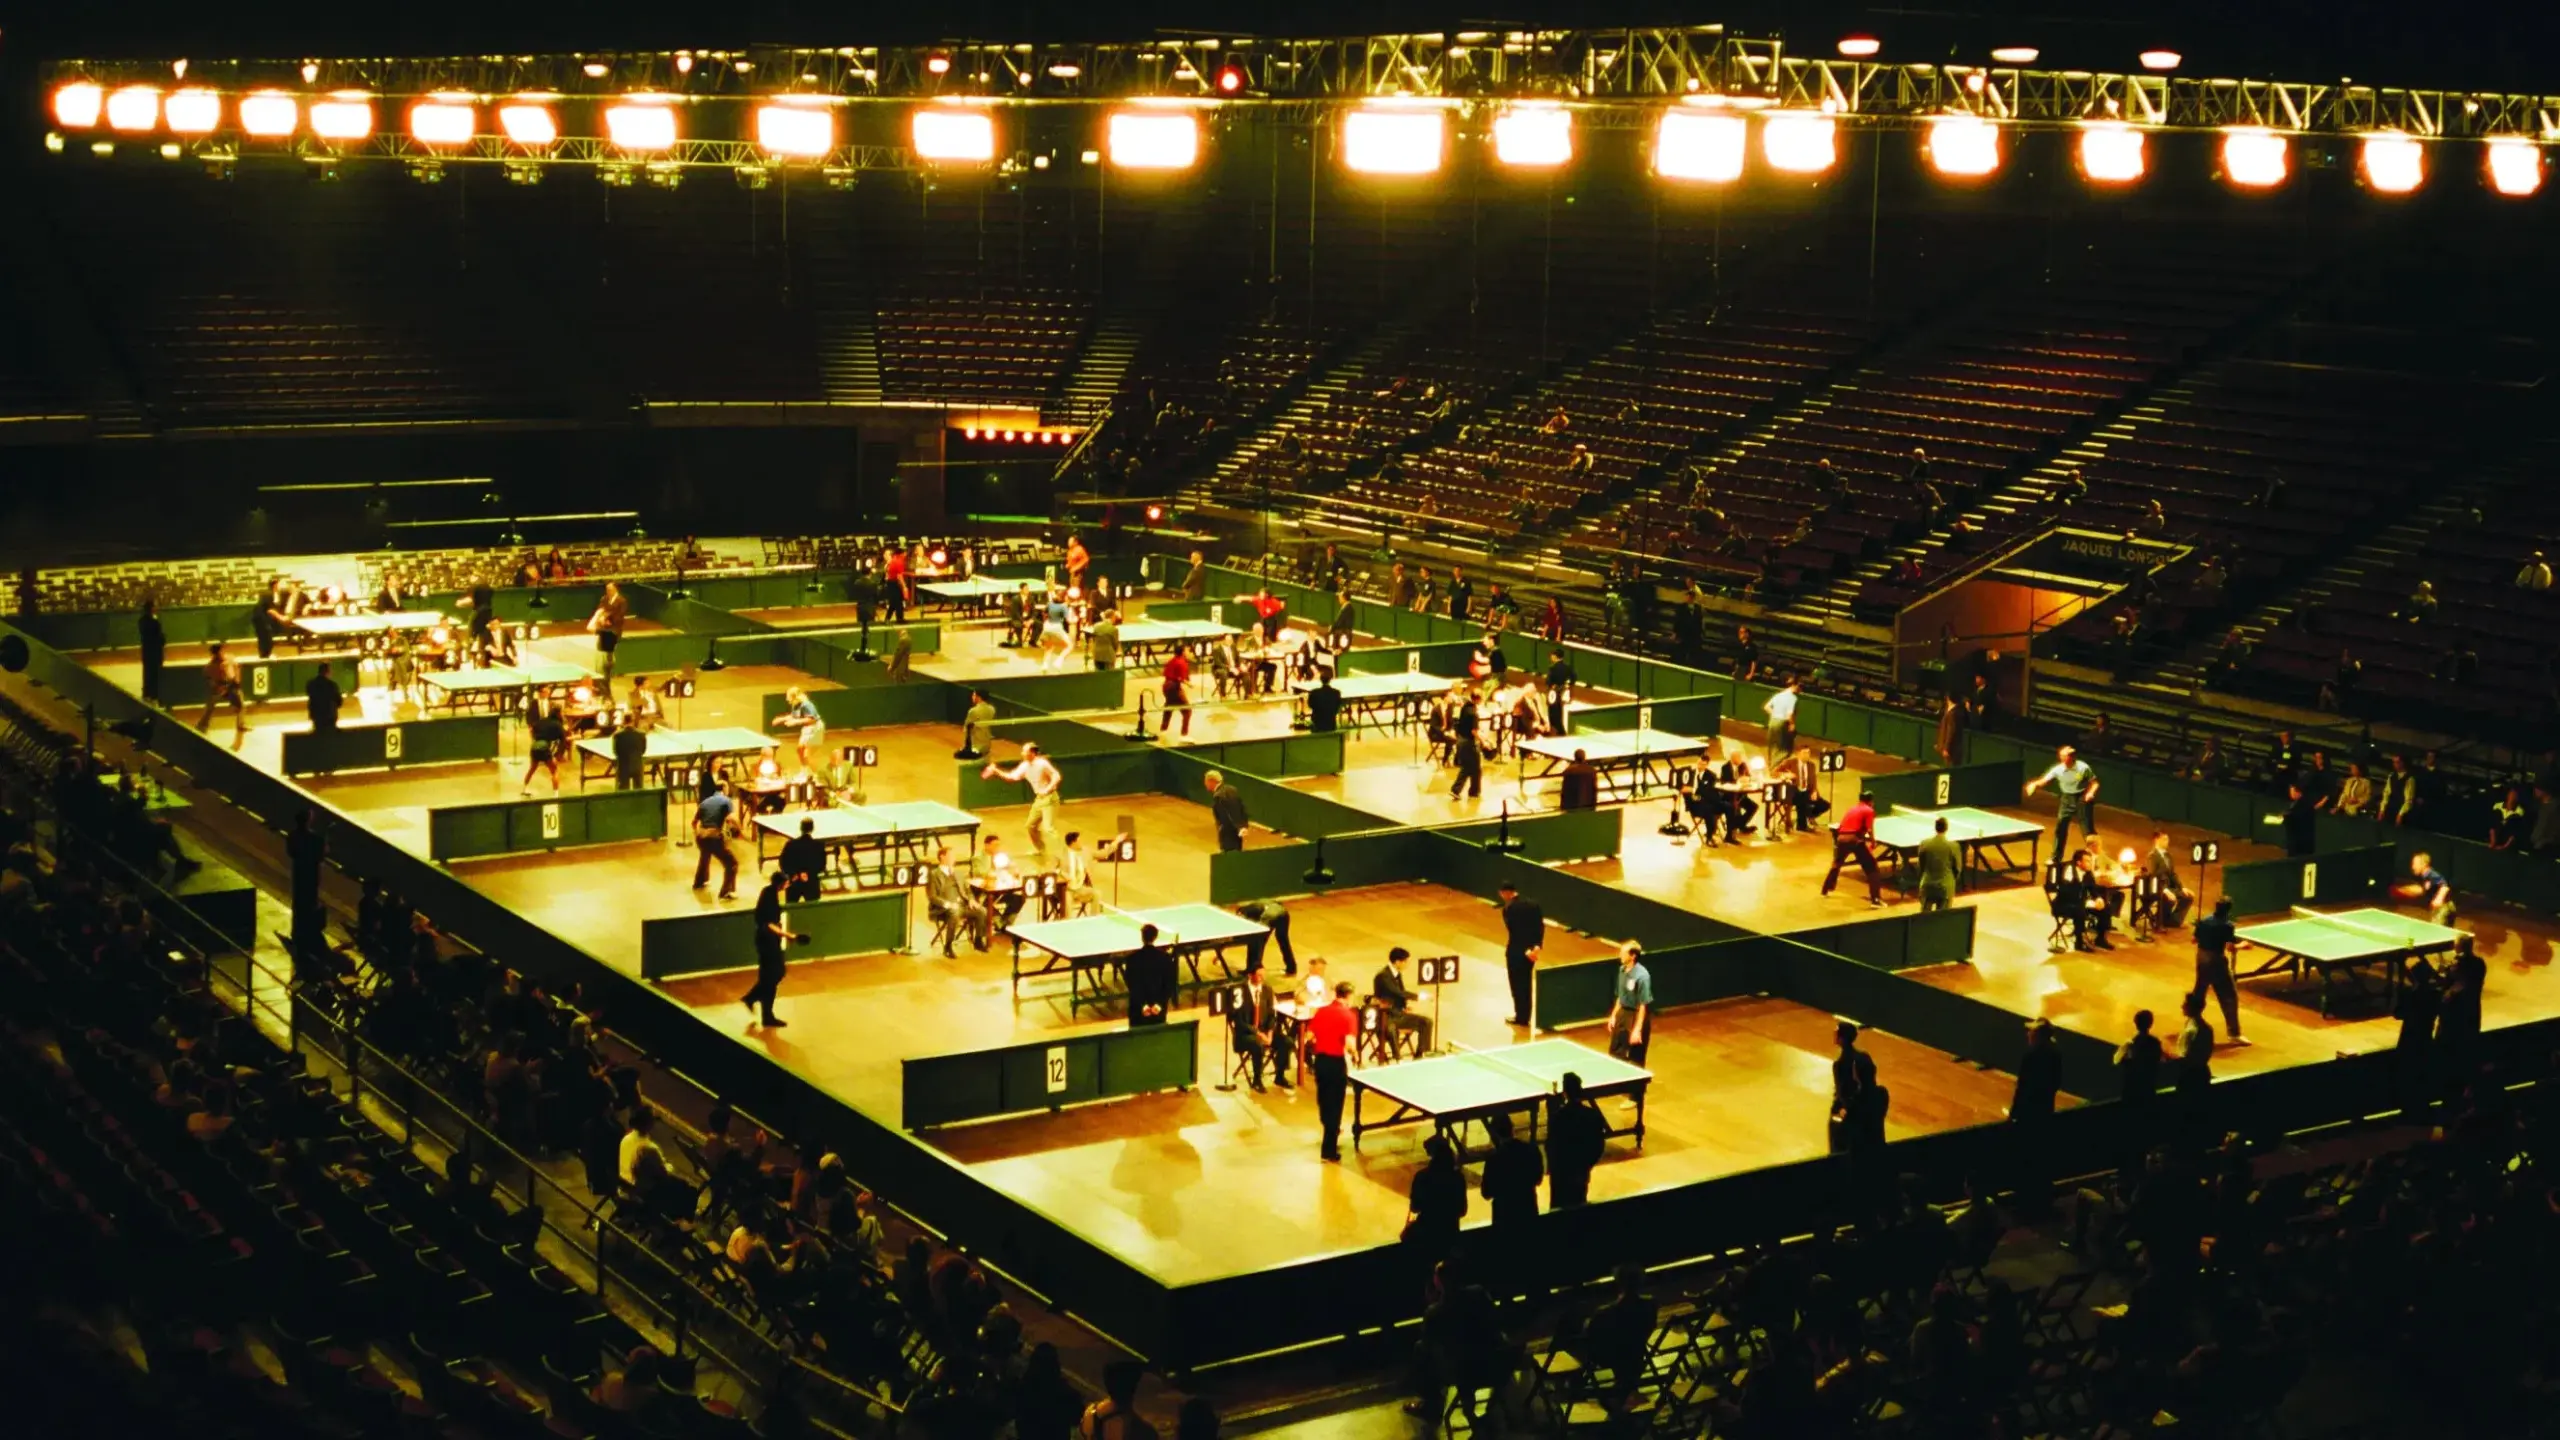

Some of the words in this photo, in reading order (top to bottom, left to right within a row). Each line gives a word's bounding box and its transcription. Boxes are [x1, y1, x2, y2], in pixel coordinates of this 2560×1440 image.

[2061, 540, 2113, 558] JAQUES
[256, 672, 265, 689] 8
[669, 681, 693, 697] 16
[387, 734, 398, 752] 9
[849, 748, 875, 765] 10
[1823, 756, 1844, 770] 20
[672, 769, 699, 786] 15
[1672, 766, 1689, 788] 10
[1765, 784, 1786, 800] 21
[1940, 780, 1949, 799] 2
[544, 813, 557, 831] 10
[2193, 843, 2217, 861] 02
[897, 865, 929, 886] 02
[1025, 875, 1055, 897] 02
[1422, 961, 1456, 982] 02
[1216, 987, 1243, 1013] 13
[1049, 1058, 1064, 1083] 12
